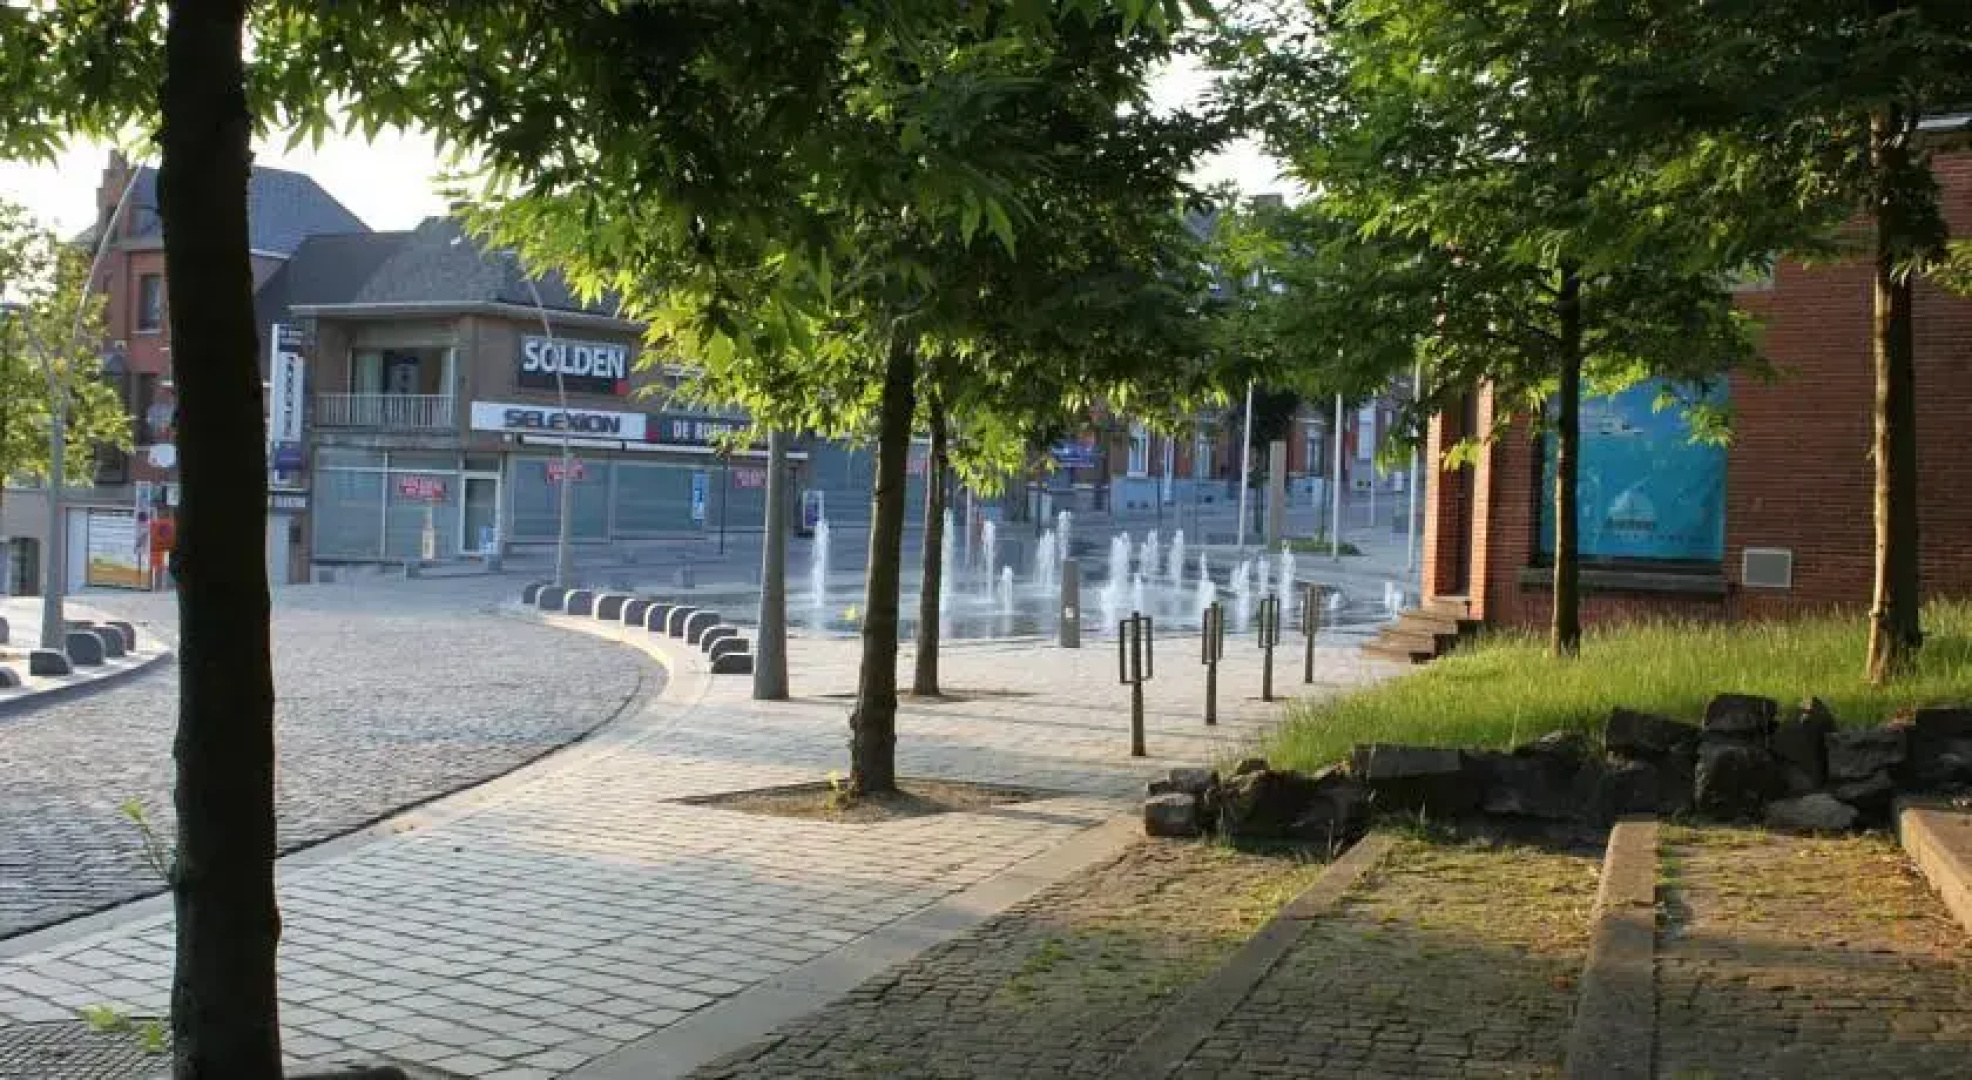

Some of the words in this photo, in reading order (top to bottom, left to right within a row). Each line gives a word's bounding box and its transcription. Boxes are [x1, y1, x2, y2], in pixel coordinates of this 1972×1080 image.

[523, 339, 625, 378] SOLDEN
[505, 408, 621, 433] SELEXION
[673, 420, 690, 440] DE
